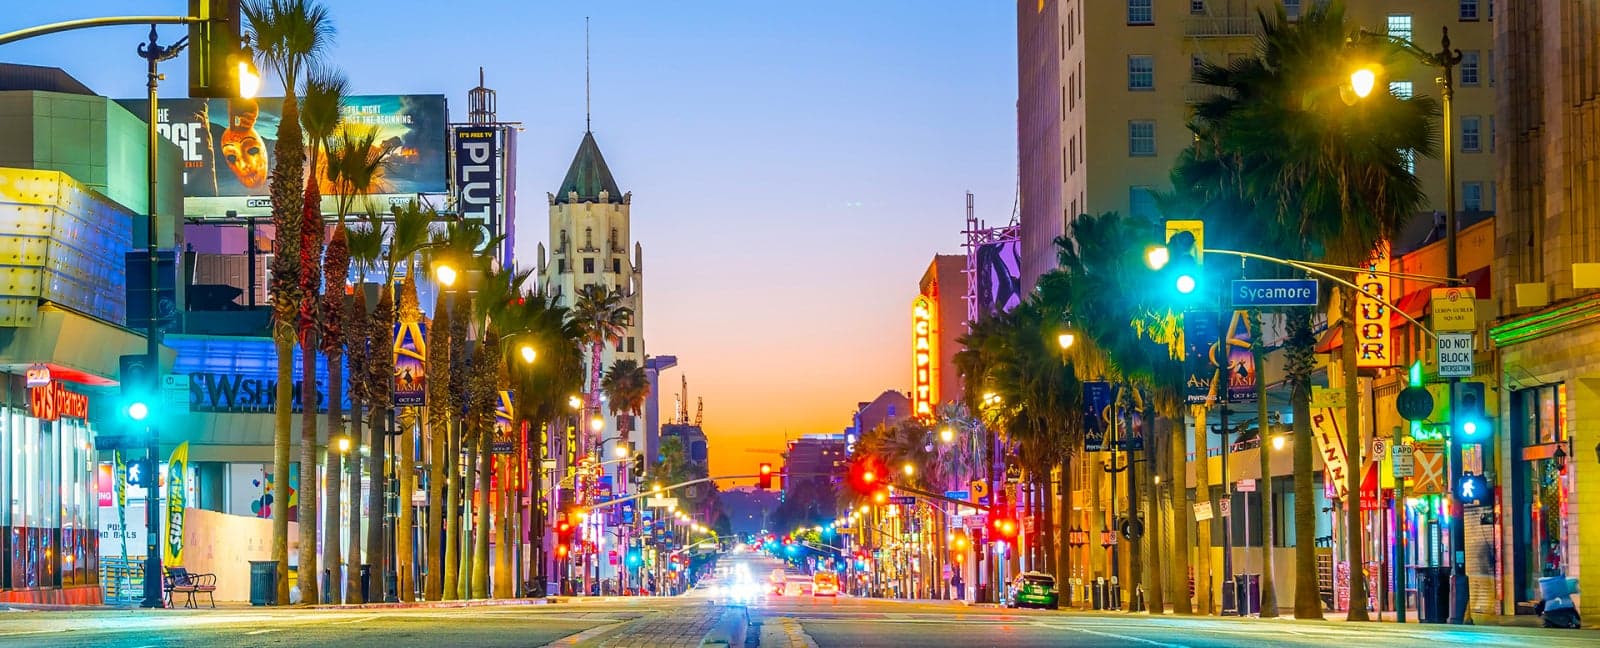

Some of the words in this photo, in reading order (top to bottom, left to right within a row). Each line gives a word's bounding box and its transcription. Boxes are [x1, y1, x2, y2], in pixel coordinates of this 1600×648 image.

[157, 108, 169, 122] HE
[1240, 286, 1311, 302] Sycamore
[1361, 252, 1386, 360] IQUOR
[1439, 339, 1451, 349] DO
[1454, 339, 1470, 349] NOT
[1441, 352, 1470, 362] BLOCK
[917, 321, 929, 414] CAPITA
[1313, 413, 1349, 498] PIZZA
